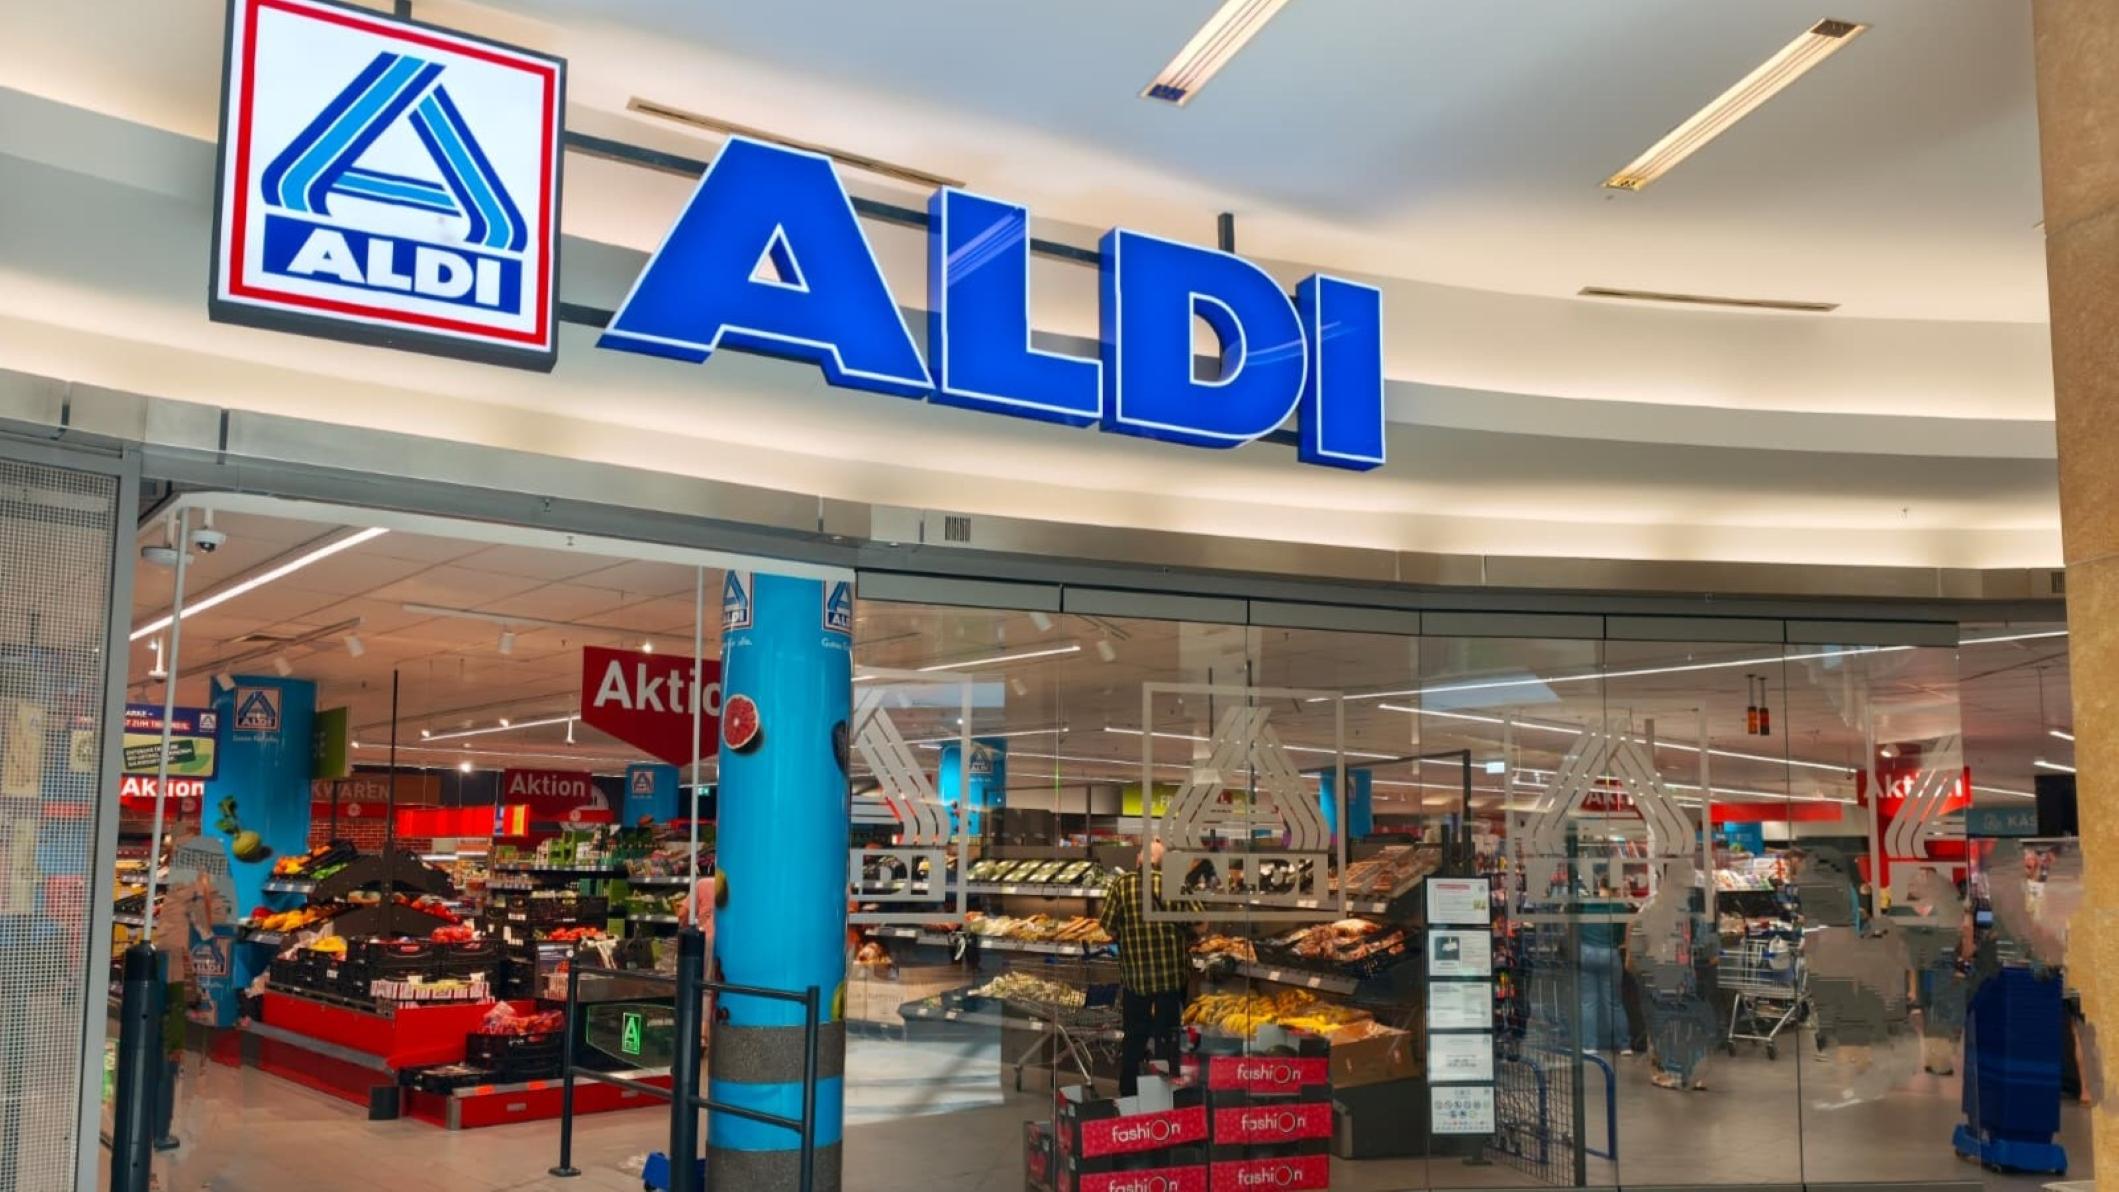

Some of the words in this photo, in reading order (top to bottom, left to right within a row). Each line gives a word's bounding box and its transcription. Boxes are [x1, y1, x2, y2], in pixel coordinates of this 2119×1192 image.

[286, 227, 501, 307] ALDI
[596, 134, 1386, 472] ALDI
[121, 778, 204, 797] Akion
[509, 773, 586, 798] Aktion
[1180, 857, 1314, 896] ALDI
